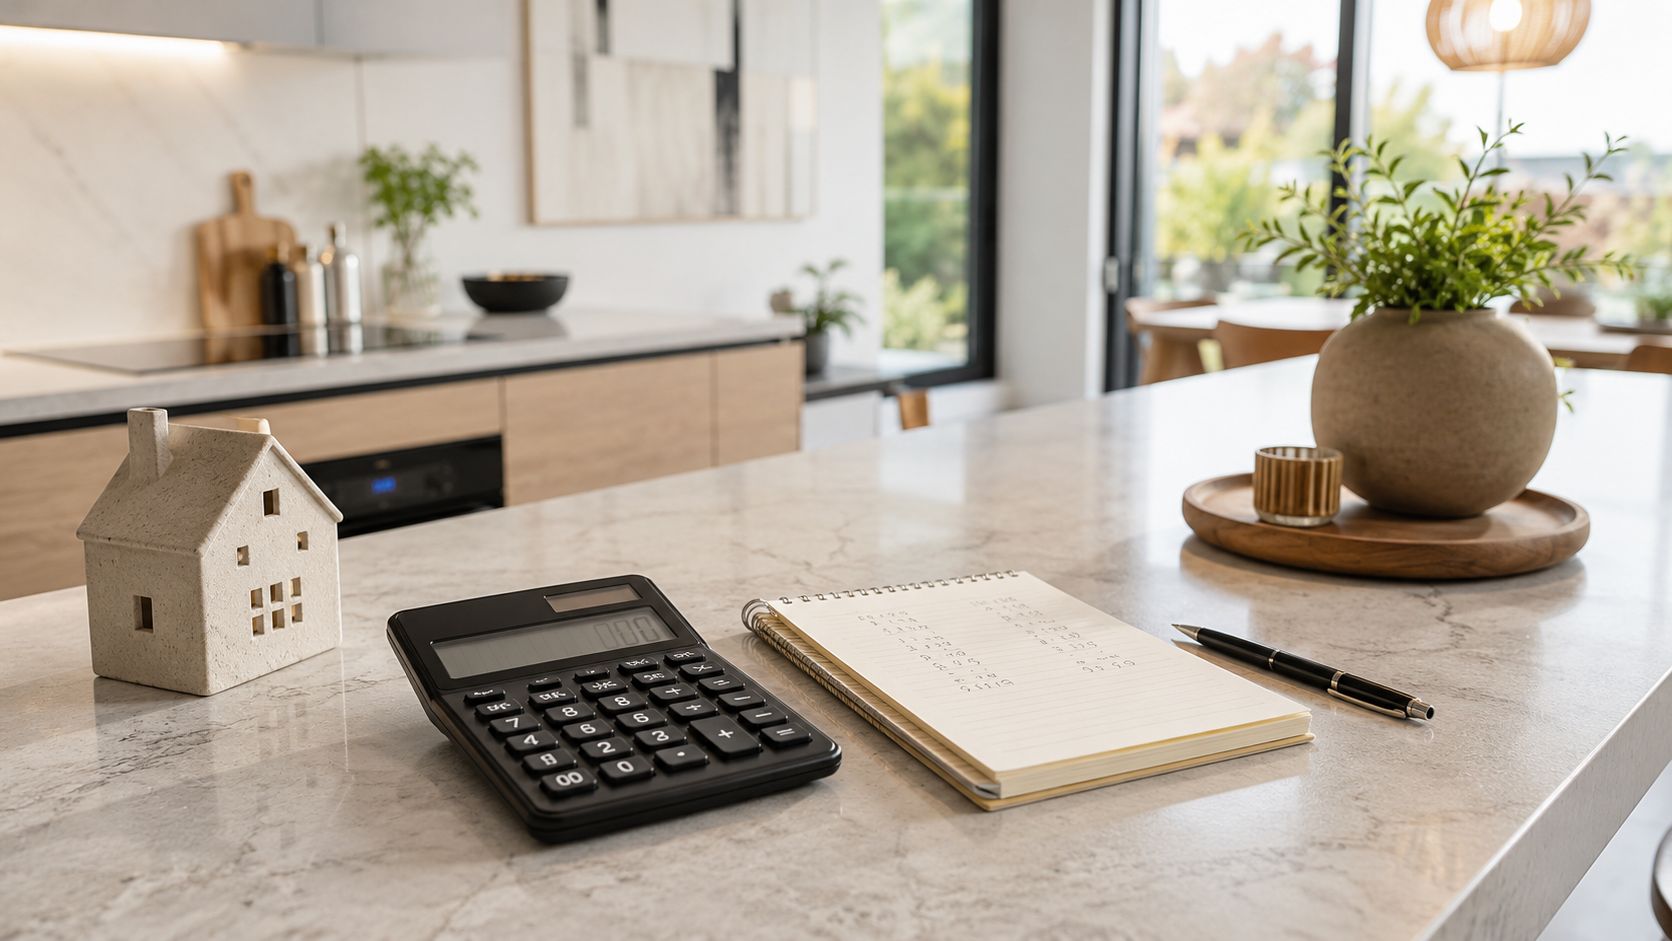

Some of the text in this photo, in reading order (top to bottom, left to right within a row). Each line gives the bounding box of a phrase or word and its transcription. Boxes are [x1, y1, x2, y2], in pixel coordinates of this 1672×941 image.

[504, 717, 519, 729] 7
[579, 723, 596, 735] 6
[596, 741, 616, 754] 2
[616, 760, 635, 774] 0
[555, 771, 584, 787] 00
